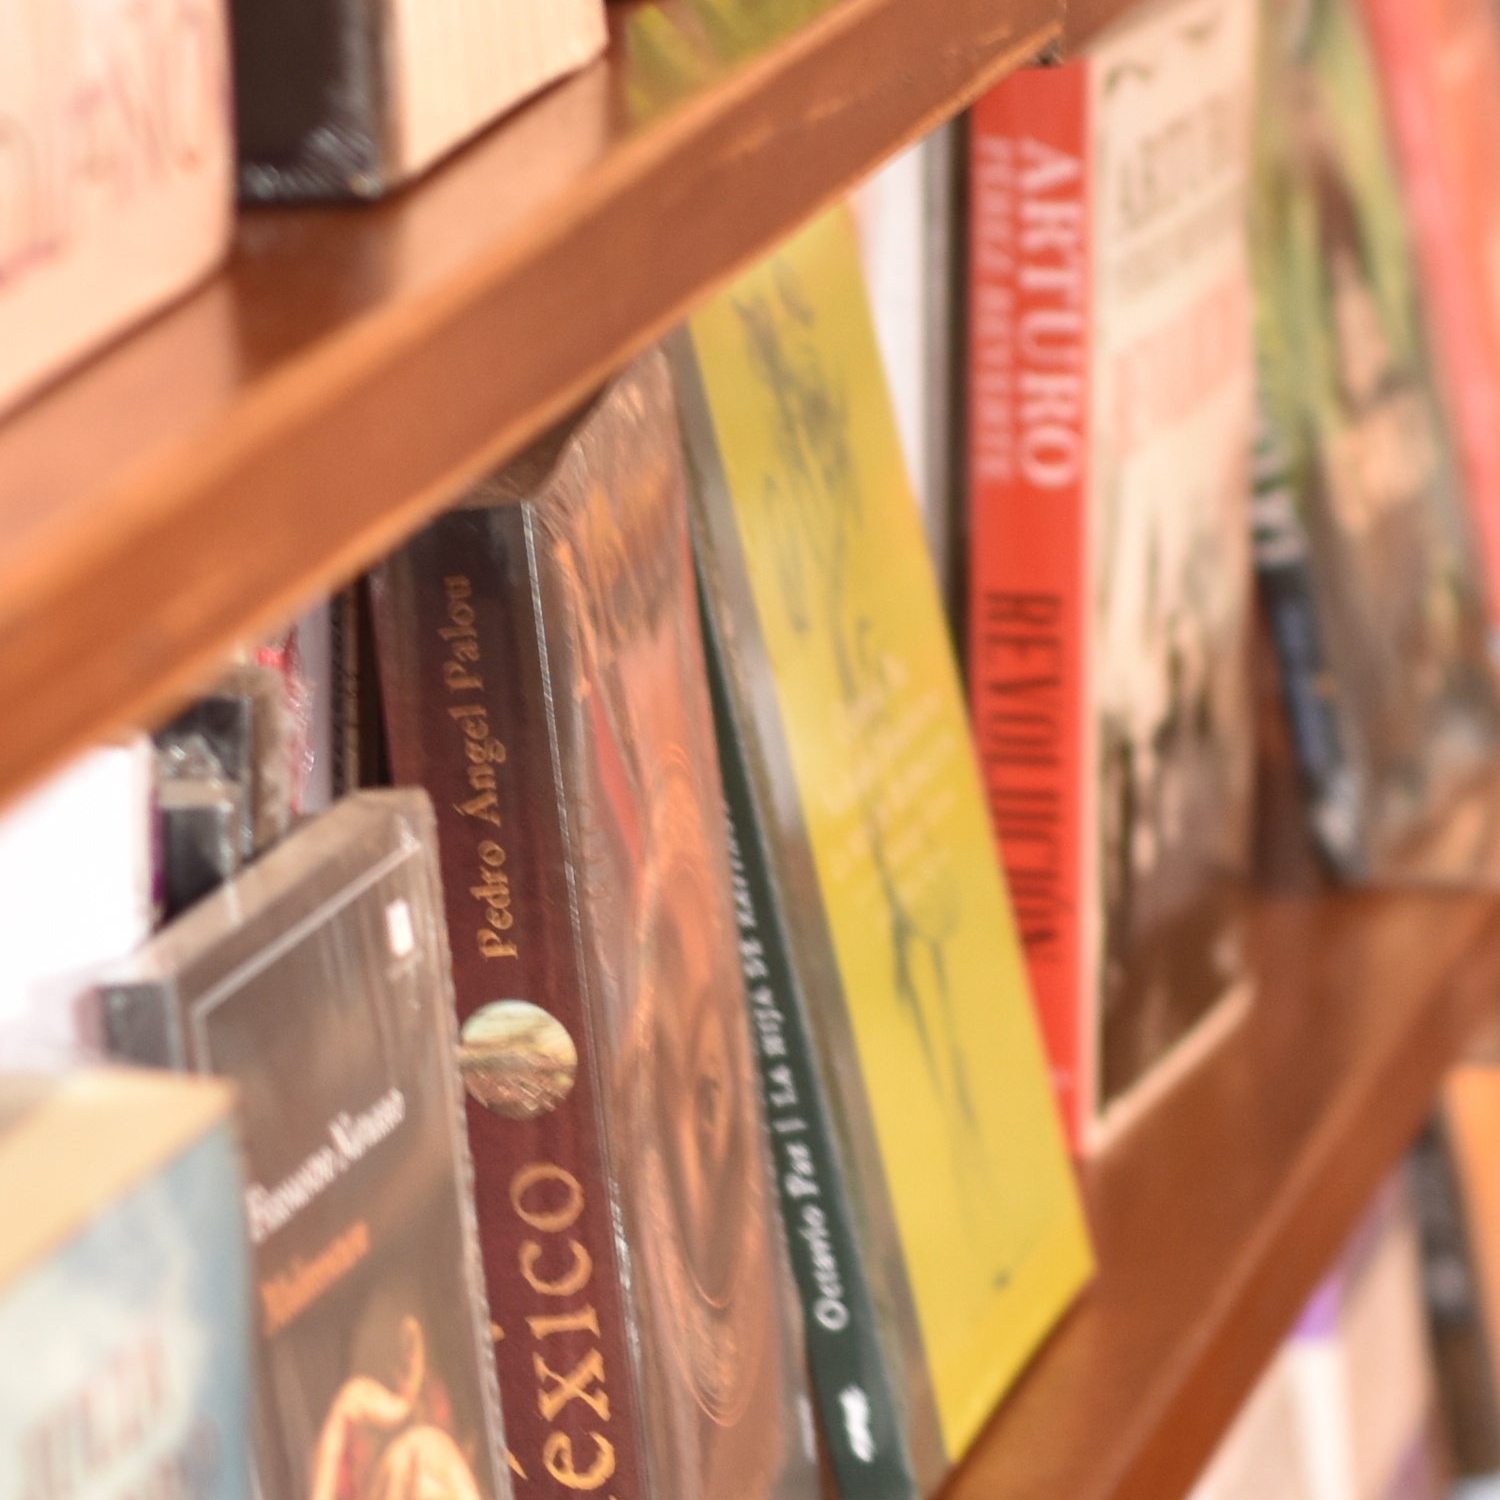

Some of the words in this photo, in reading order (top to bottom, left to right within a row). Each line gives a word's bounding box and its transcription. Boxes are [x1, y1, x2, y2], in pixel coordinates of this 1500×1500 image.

[1015, 135, 1086, 490] ARTURO
[438, 572, 485, 693] Palou
[447, 703, 508, 828] Ángel
[469, 838, 520, 961] Pedro
[784, 1141, 820, 1199] Paz
[798, 1203, 850, 1332] Octavio
[490, 1161, 617, 1500] éxico
